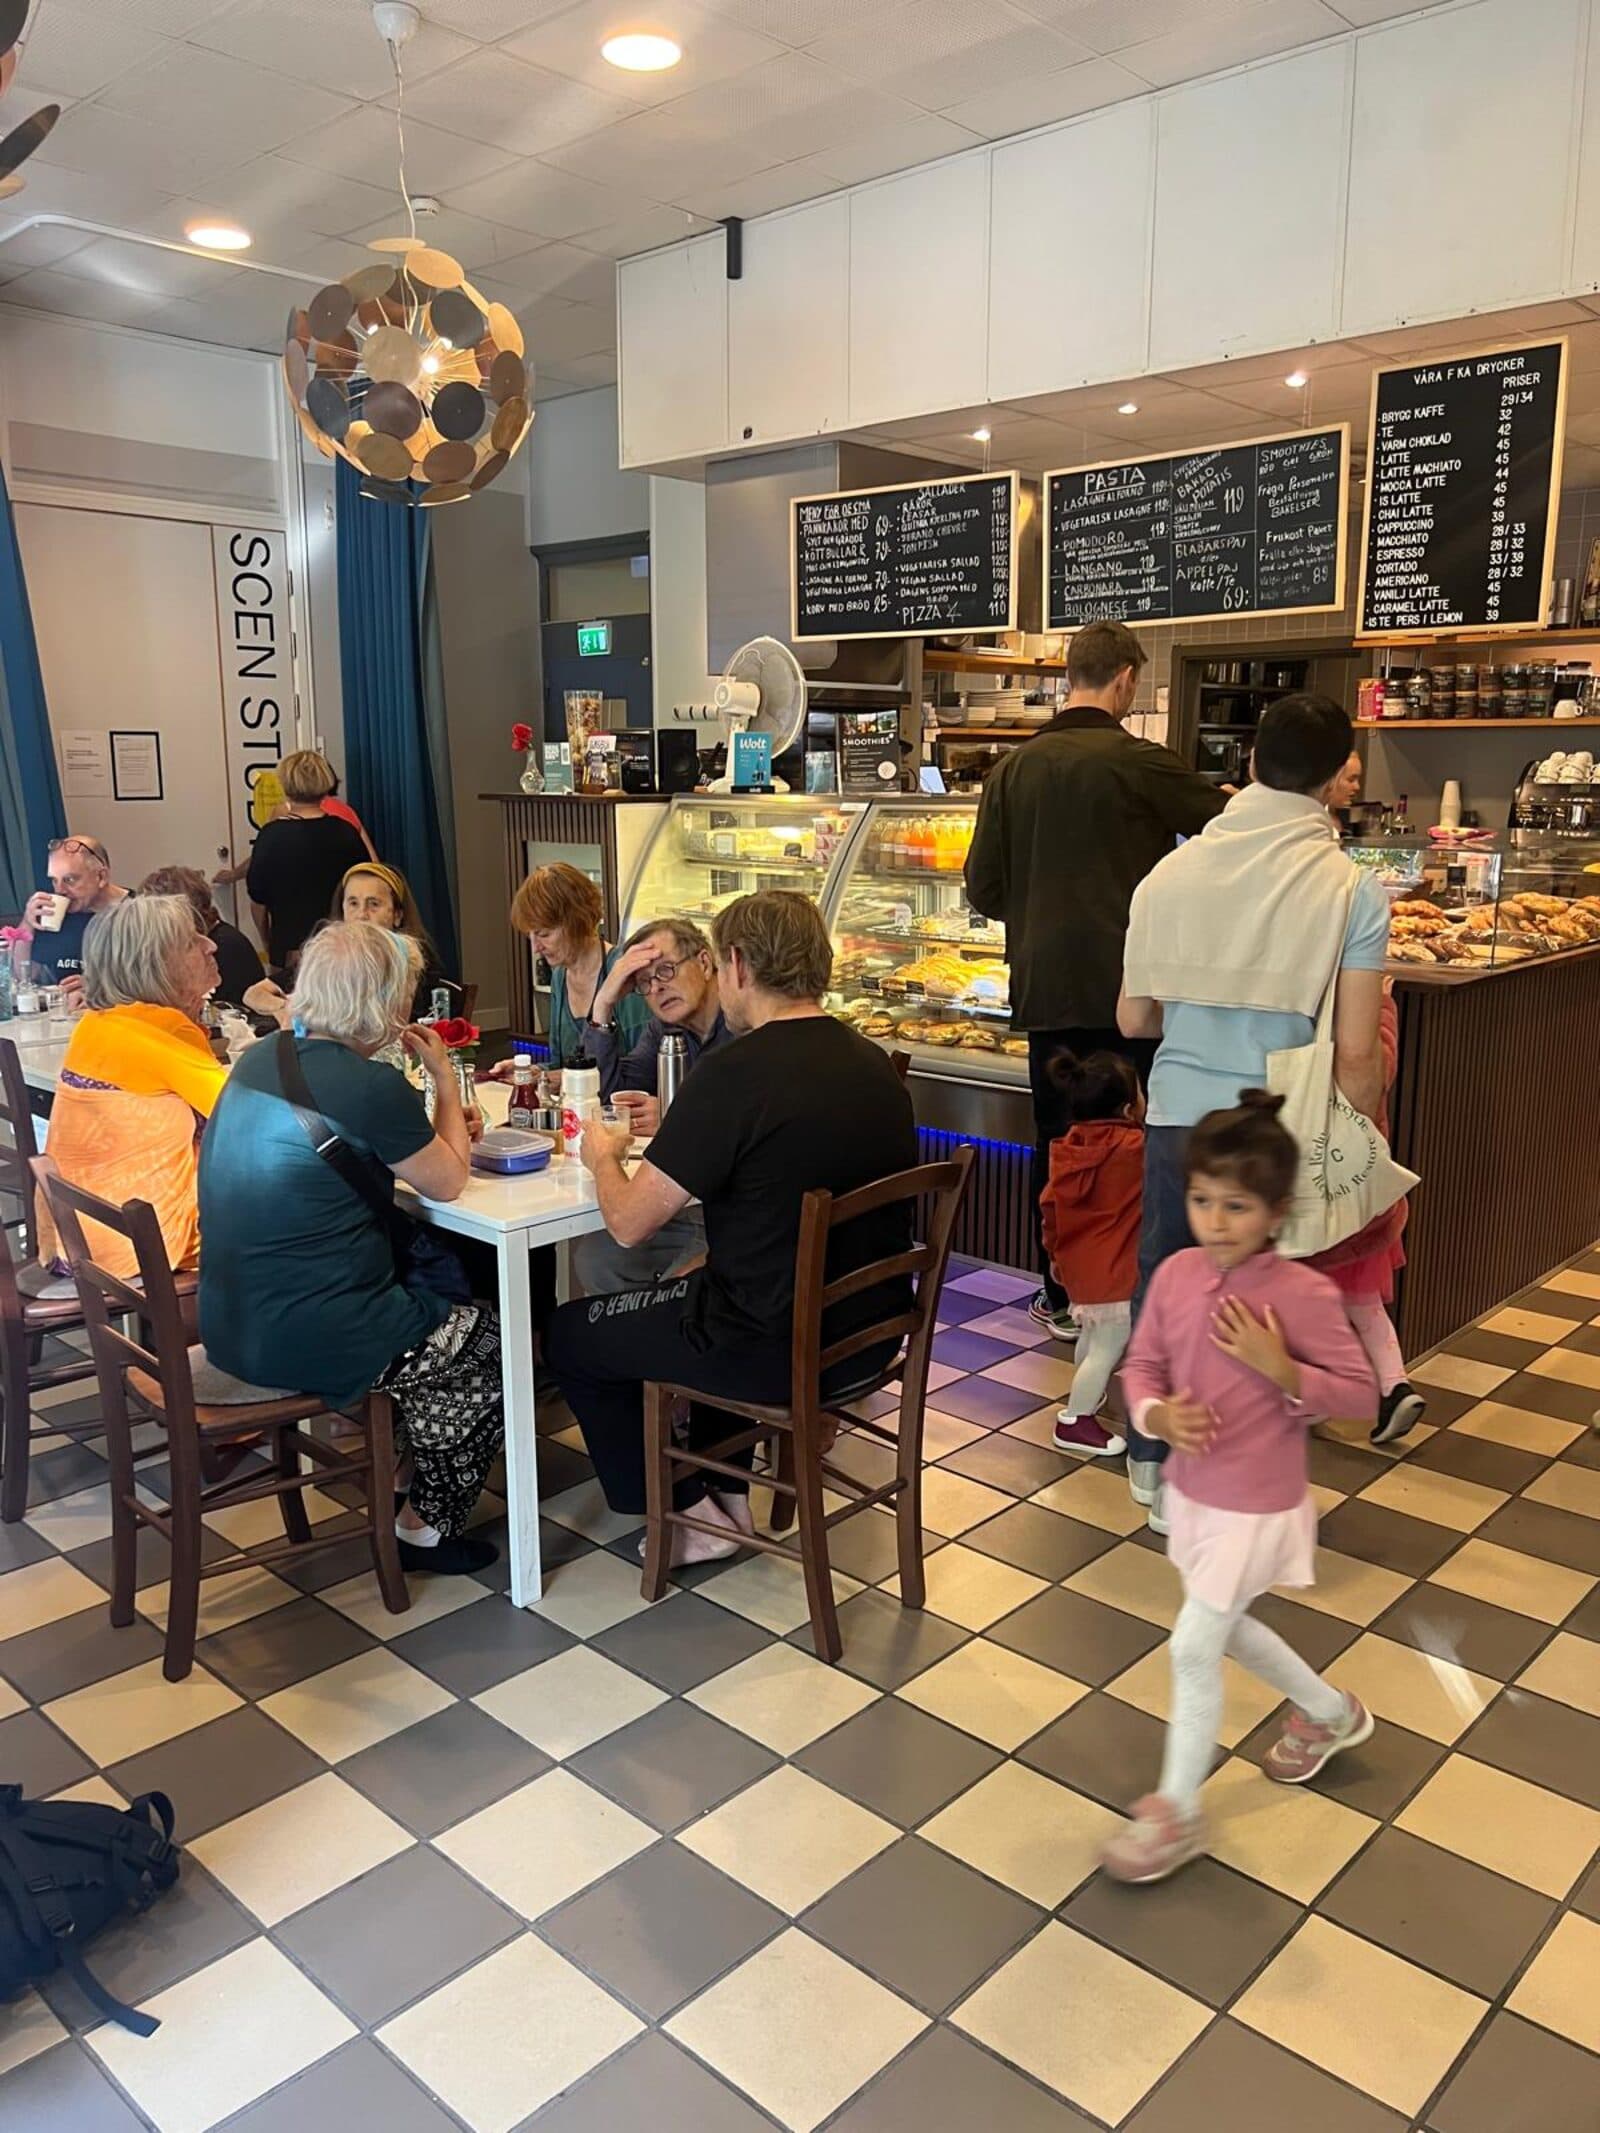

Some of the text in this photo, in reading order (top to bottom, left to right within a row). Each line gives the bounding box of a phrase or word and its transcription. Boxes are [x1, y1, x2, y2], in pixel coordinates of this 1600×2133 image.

[1414, 369, 1442, 385] VÅRA
[1476, 357, 1525, 376] DRYCKER
[1503, 372, 1540, 389] PRISER
[1414, 404, 1445, 418] KAFFE
[1382, 409, 1512, 437] TE 32
[1382, 424, 1511, 452] VARM CHOKLAD 42
[1381, 439, 1510, 465] LATTE 45
[1381, 454, 1509, 479] LATTE MACHIATO 45
[1084, 467, 1146, 495] PASTA
[1380, 469, 1508, 492] MOCCA LATTE 44
[1224, 486, 1244, 514] 119
[1380, 482, 1507, 506] IS LATTE 45
[1378, 497, 1505, 520] CHAI LATTE 45
[1377, 512, 1504, 534] CAPPUCCINO 39
[1377, 533, 1429, 547] MACCHIATO
[1377, 547, 1424, 561] ESPRESSO
[1376, 561, 1417, 574] CORTADO
[1374, 581, 1500, 600] VANILJ LATTE 45
[1375, 574, 1429, 588] AMERICANO
[230, 533, 277, 679] SCEN
[902, 604, 941, 625] PIZZA
[1373, 595, 1499, 614] CARAMEL LATTE 45
[1396, 613, 1419, 625] PERS
[1431, 612, 1463, 624] LEMON
[1486, 609, 1499, 621] 39
[740, 737, 767, 749] Wolt
[843, 737, 890, 746] SMOOTHIES
